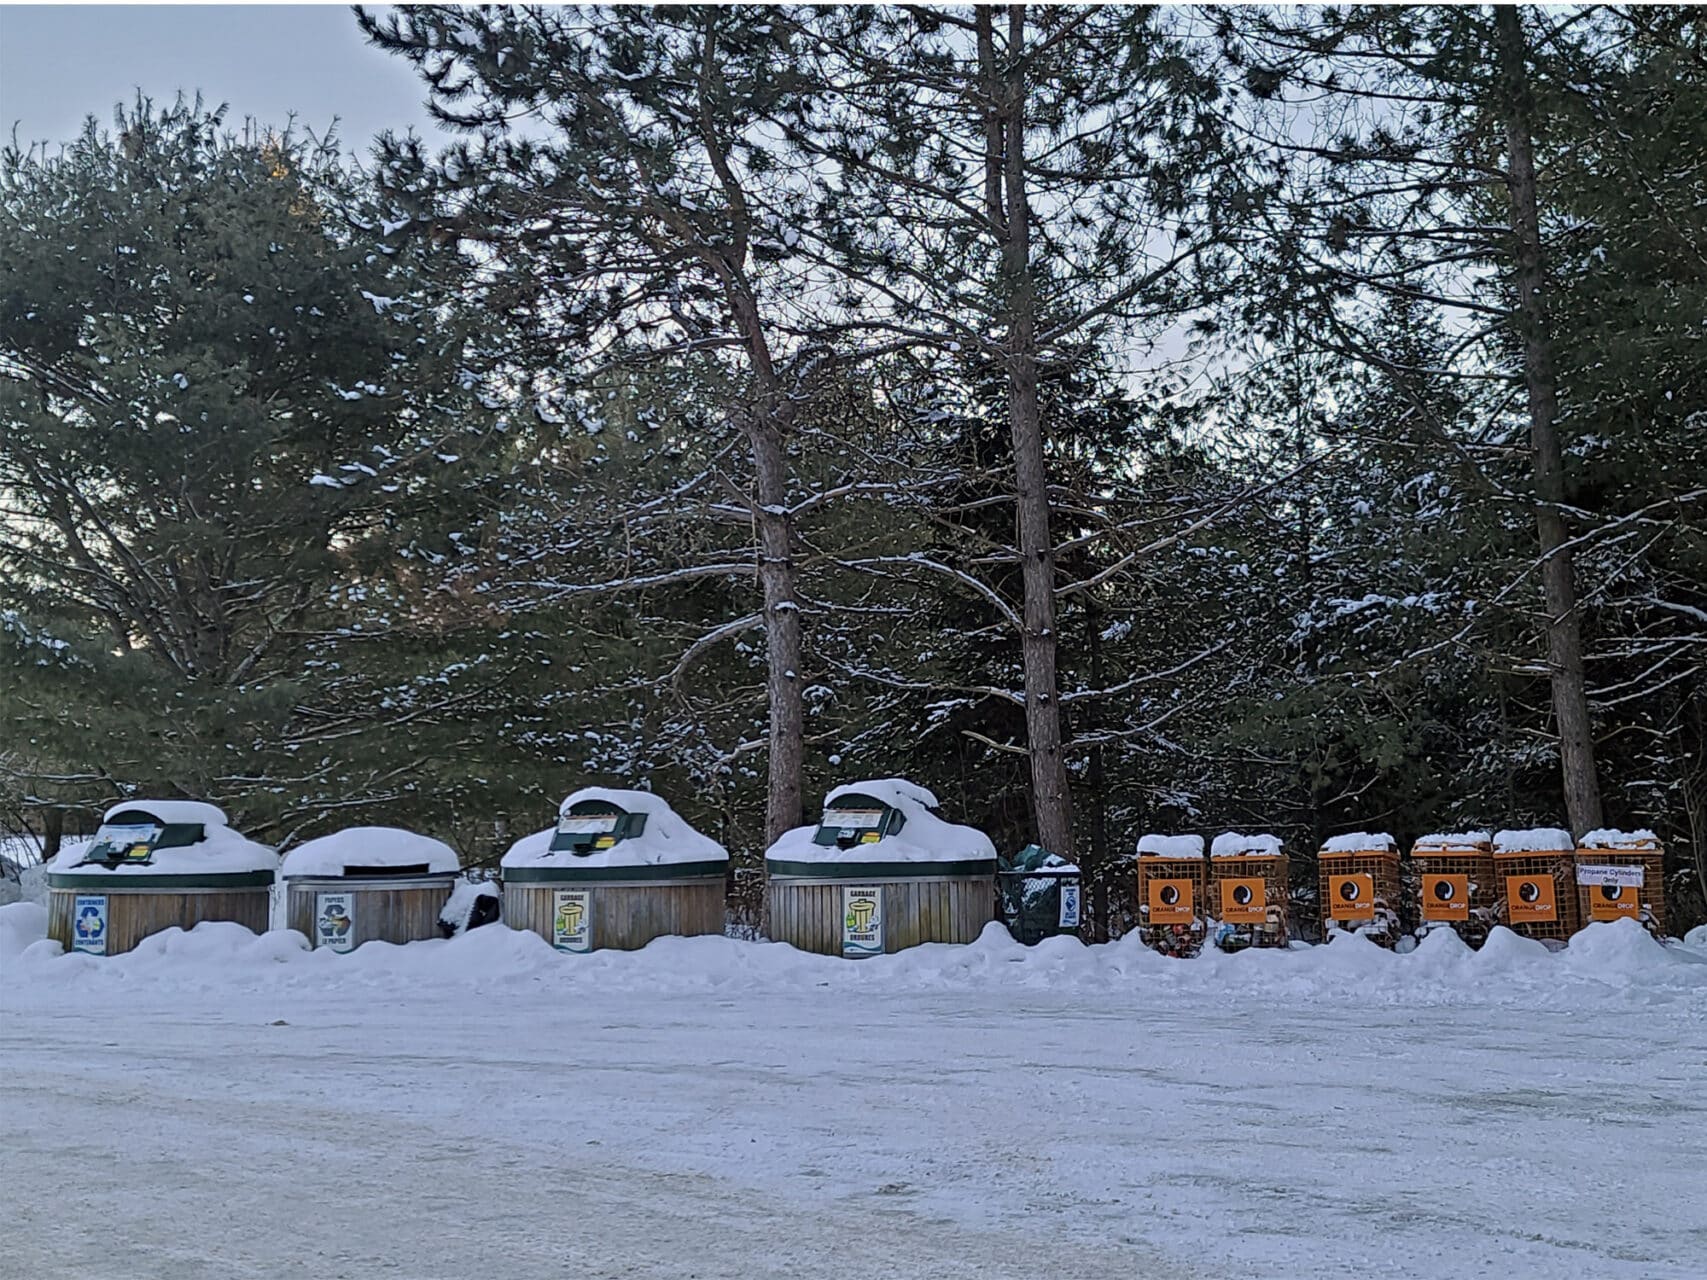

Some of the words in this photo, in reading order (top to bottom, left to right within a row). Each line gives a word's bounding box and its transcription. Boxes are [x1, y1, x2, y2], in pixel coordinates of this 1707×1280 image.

[1580, 868, 1607, 876] Propane
[1609, 869, 1641, 877] Cylinders
[1603, 876, 1618, 884] Only
